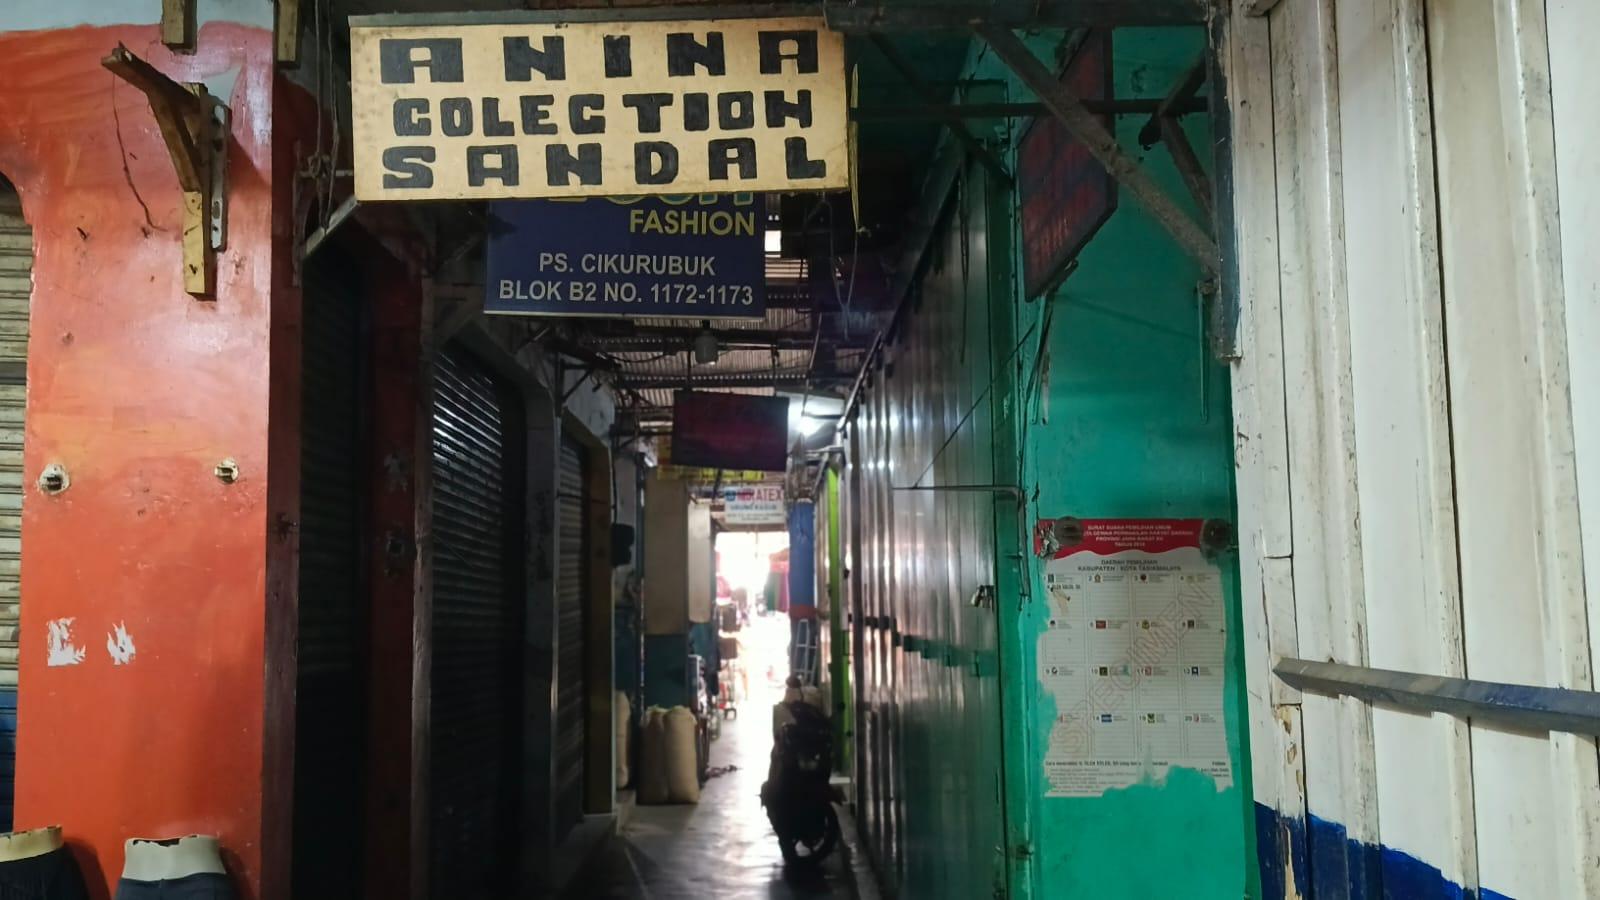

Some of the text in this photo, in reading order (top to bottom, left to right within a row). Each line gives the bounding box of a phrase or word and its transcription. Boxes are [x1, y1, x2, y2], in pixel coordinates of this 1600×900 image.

[379, 29, 819, 84] ANINA
[393, 89, 813, 137] COLECTION
[382, 137, 826, 189] SANDAL
[629, 209, 755, 236] FASHION
[539, 252, 716, 276] PS. CIKURUBUK
[499, 279, 754, 305] BLOK B2 NO. 1172-1173
